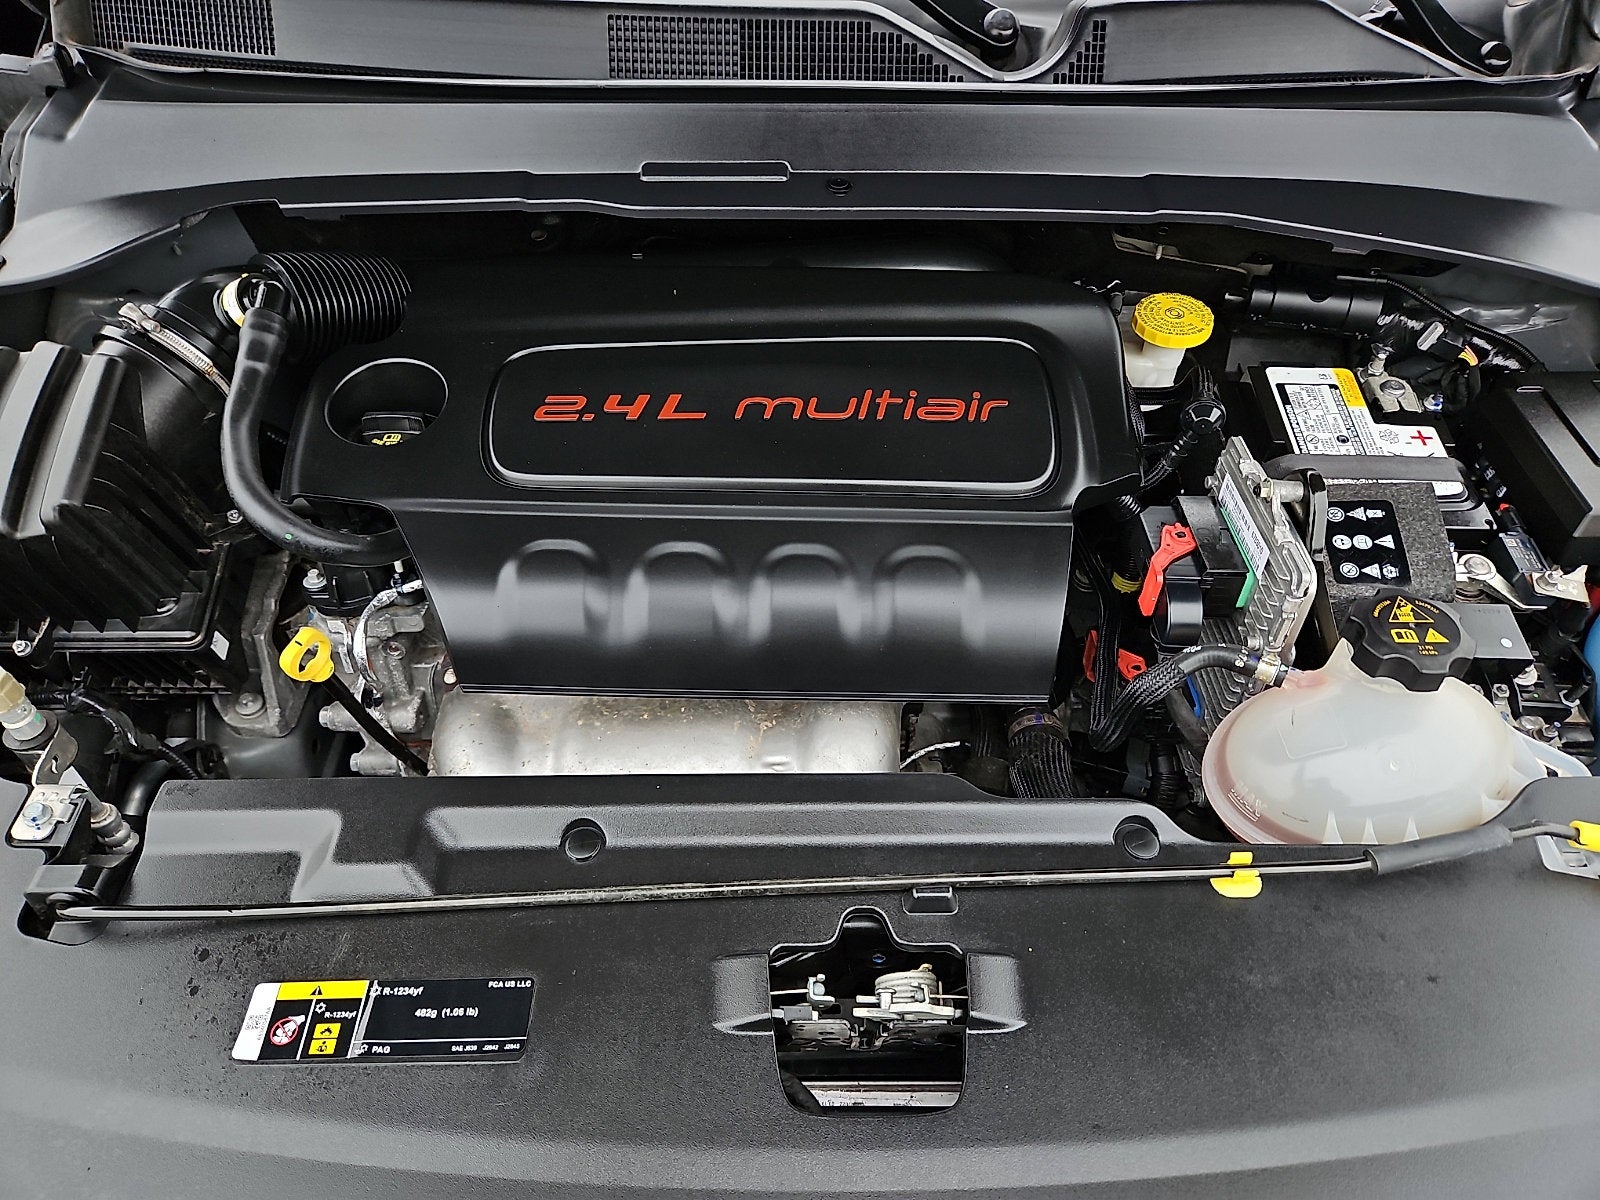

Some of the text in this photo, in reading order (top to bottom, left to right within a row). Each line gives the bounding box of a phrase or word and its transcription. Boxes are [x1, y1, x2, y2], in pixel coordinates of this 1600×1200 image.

[735, 389, 1008, 421] multiair
[488, 980, 531, 988] FCA US LLC
[382, 986, 424, 996] R-1234yf
[324, 1010, 357, 1019] R-1234yf
[441, 1007, 464, 1018] (1.06
[465, 1006, 478, 1017] lb)
[371, 1045, 391, 1054] PAG
